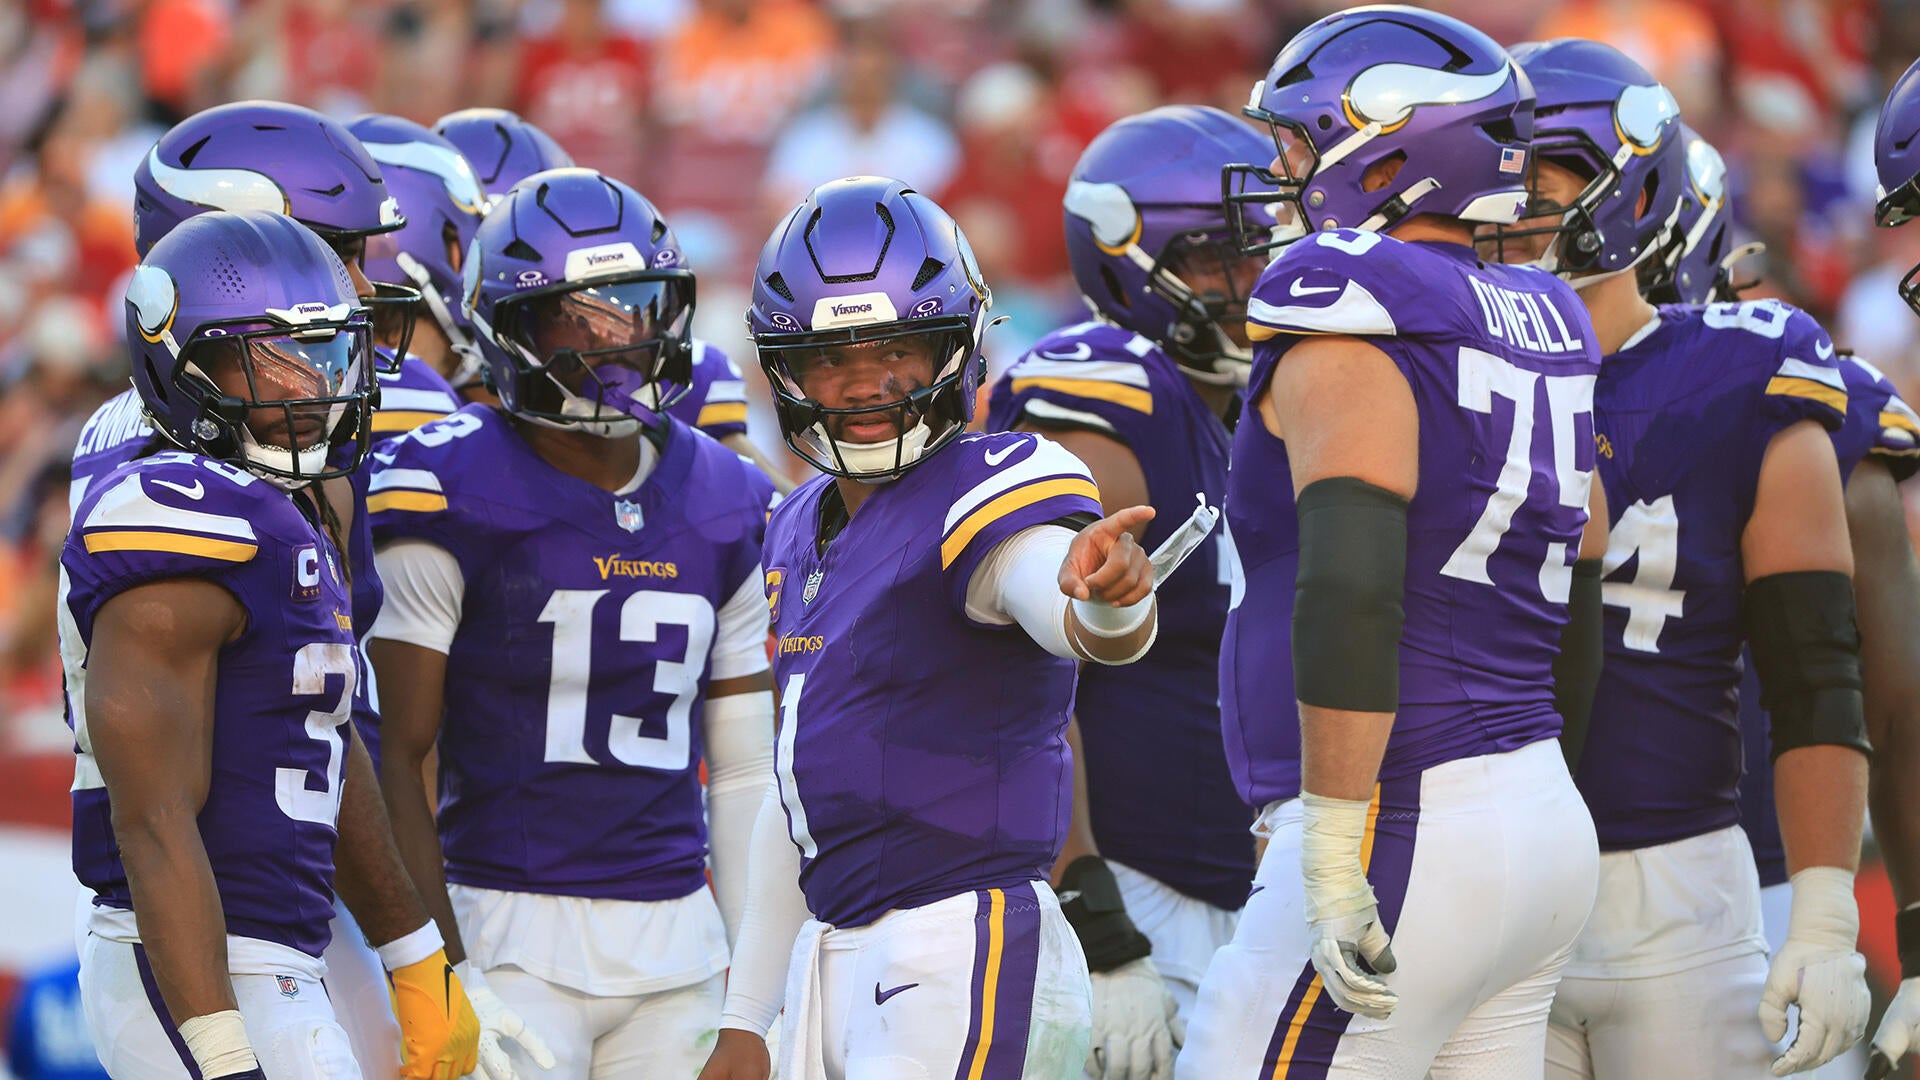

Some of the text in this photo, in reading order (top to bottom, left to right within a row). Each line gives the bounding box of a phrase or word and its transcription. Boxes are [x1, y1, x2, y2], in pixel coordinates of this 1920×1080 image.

[298, 547, 320, 588] C
[1440, 346, 1598, 605] 75
[275, 642, 361, 831] 3
[536, 588, 716, 771] 13
[778, 672, 819, 859] 1
